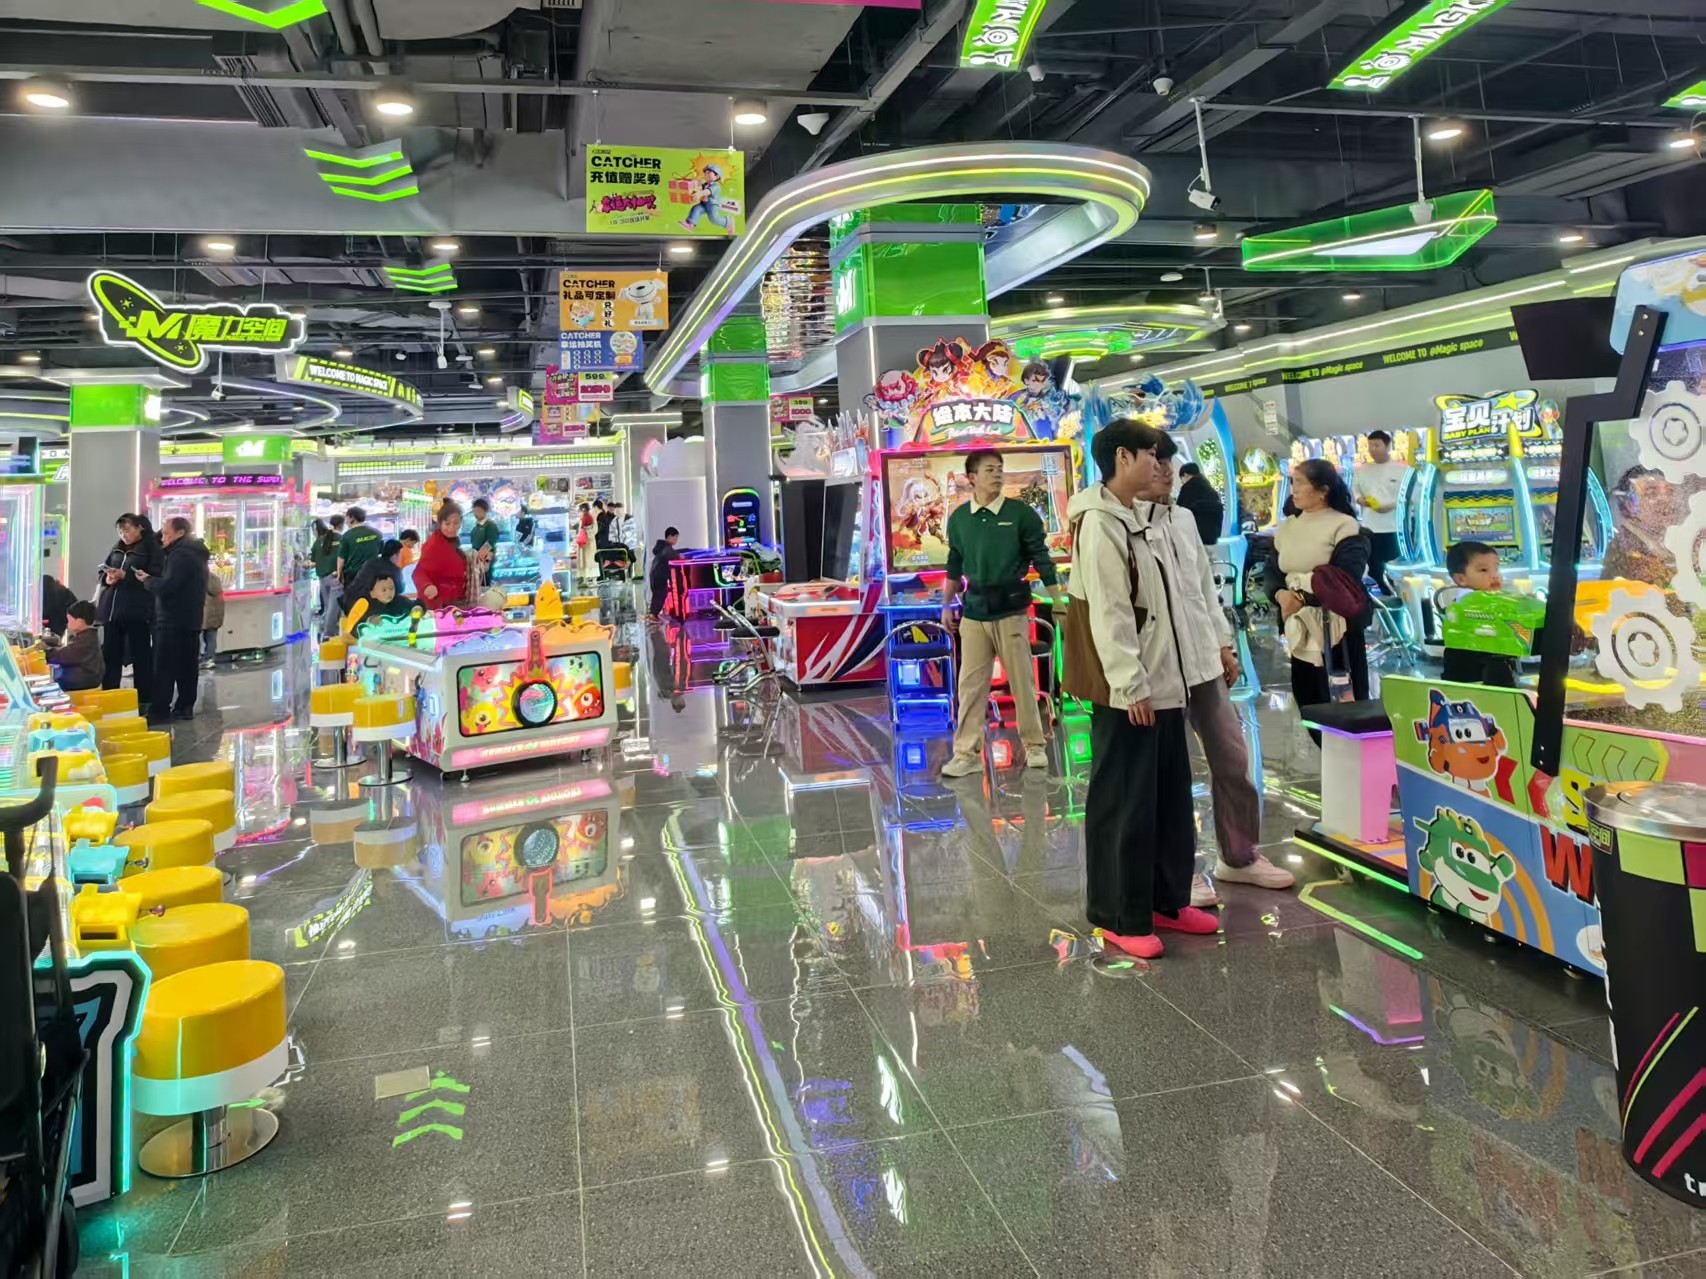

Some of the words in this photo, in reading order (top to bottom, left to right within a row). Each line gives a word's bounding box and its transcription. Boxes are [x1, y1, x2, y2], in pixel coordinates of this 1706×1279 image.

[591, 156, 661, 169] CATCHER
[590, 171, 660, 185] 充值赠奖券
[563, 280, 615, 288] CATCHER
[563, 291, 615, 300] 礼品可定制
[1382, 350, 1417, 364] WELCOME
[1417, 347, 1427, 358] TO
[308, 364, 346, 380] WELCOME
[346, 372, 355, 382] TO
